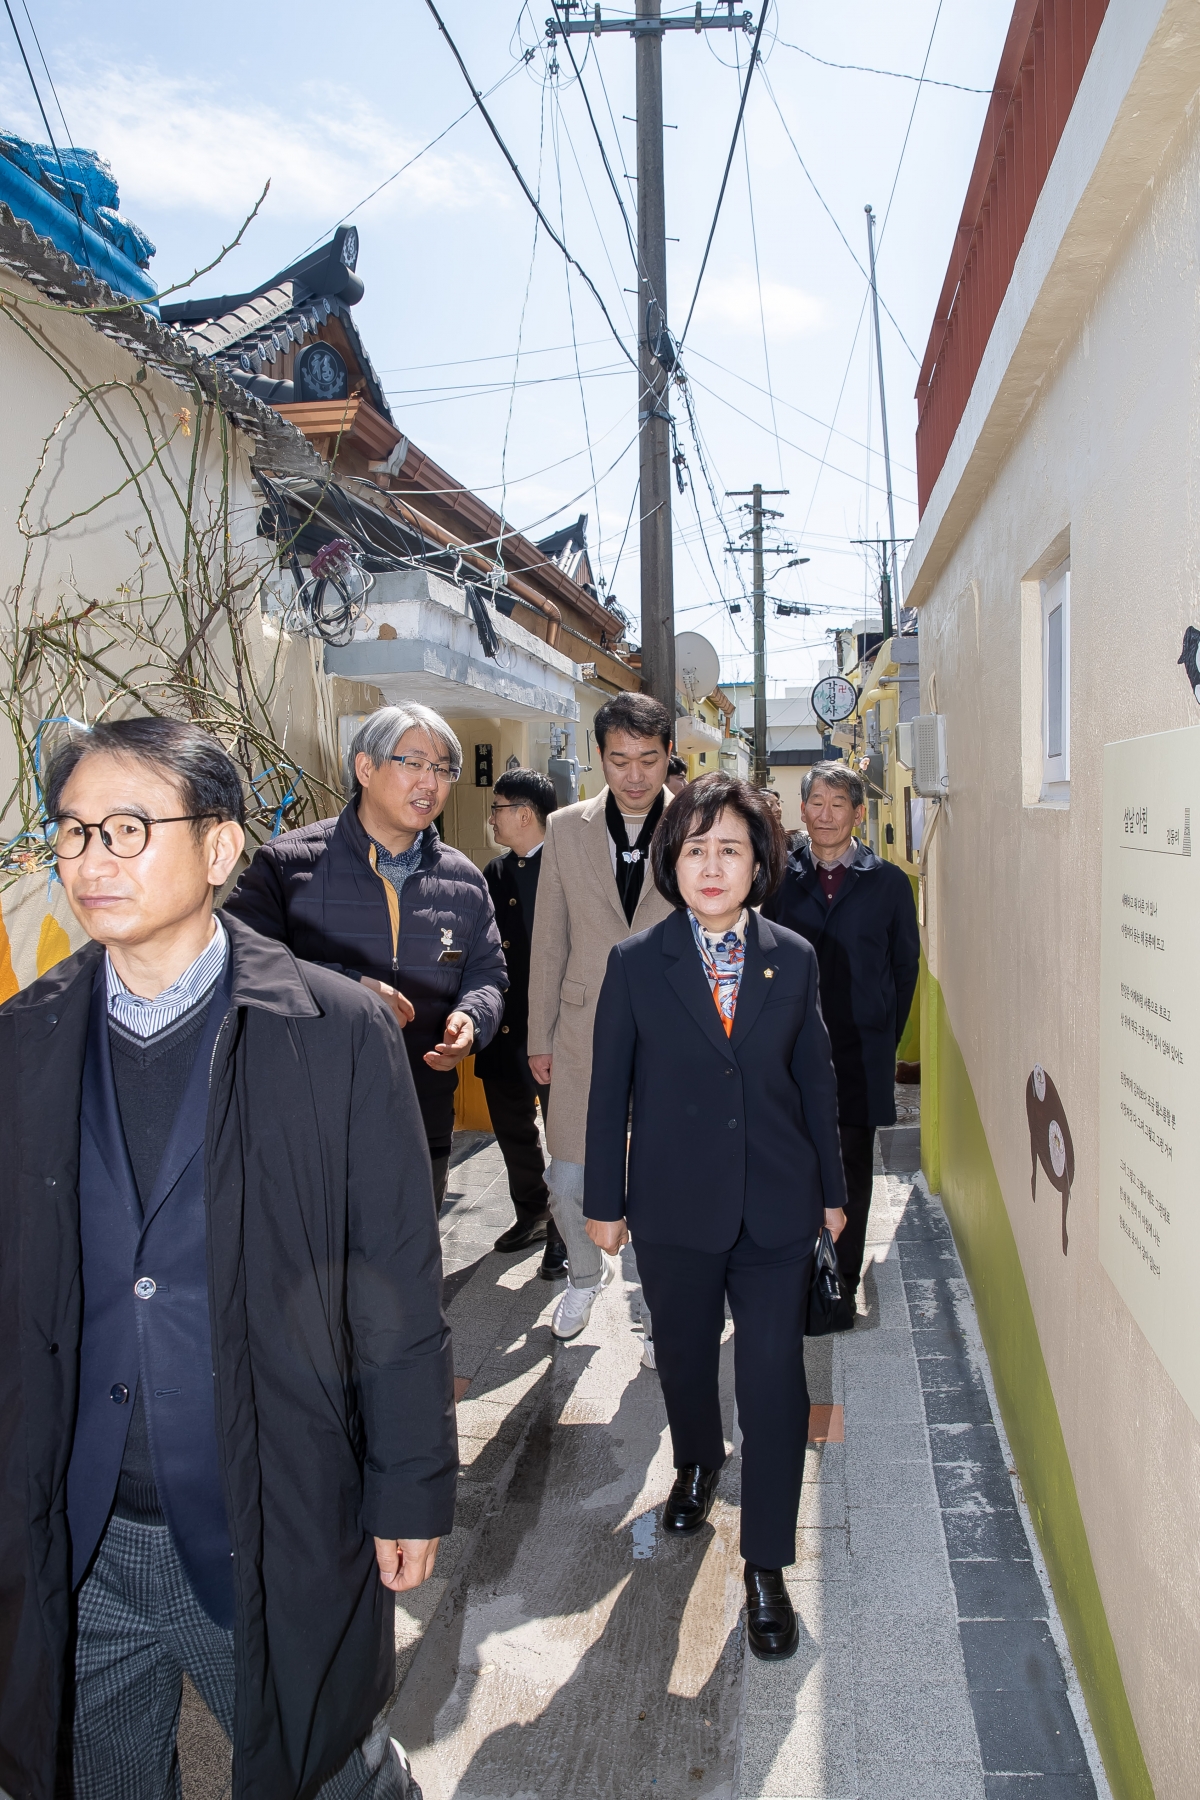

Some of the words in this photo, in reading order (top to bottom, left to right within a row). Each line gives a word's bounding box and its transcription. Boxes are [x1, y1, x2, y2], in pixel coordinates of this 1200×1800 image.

[310, 353, 334, 382] 福
[825, 681, 838, 717] 각성사
[1123, 807, 1134, 833] 설날
[1136, 807, 1147, 834] 아침
[1166, 829, 1179, 846] 김동리
[1138, 898, 1144, 914] 다른
[1145, 900, 1149, 915] 거
[1121, 923, 1133, 941] 아침마다
[1156, 938, 1164, 951] 뜨고
[1144, 996, 1158, 1014] 서쪽으로
[1159, 1004, 1171, 1022] 흐르고
[1171, 1046, 1184, 1064] 있어도
[1147, 1095, 1155, 1112] 조금
[1145, 1124, 1155, 1142] 그렇고
